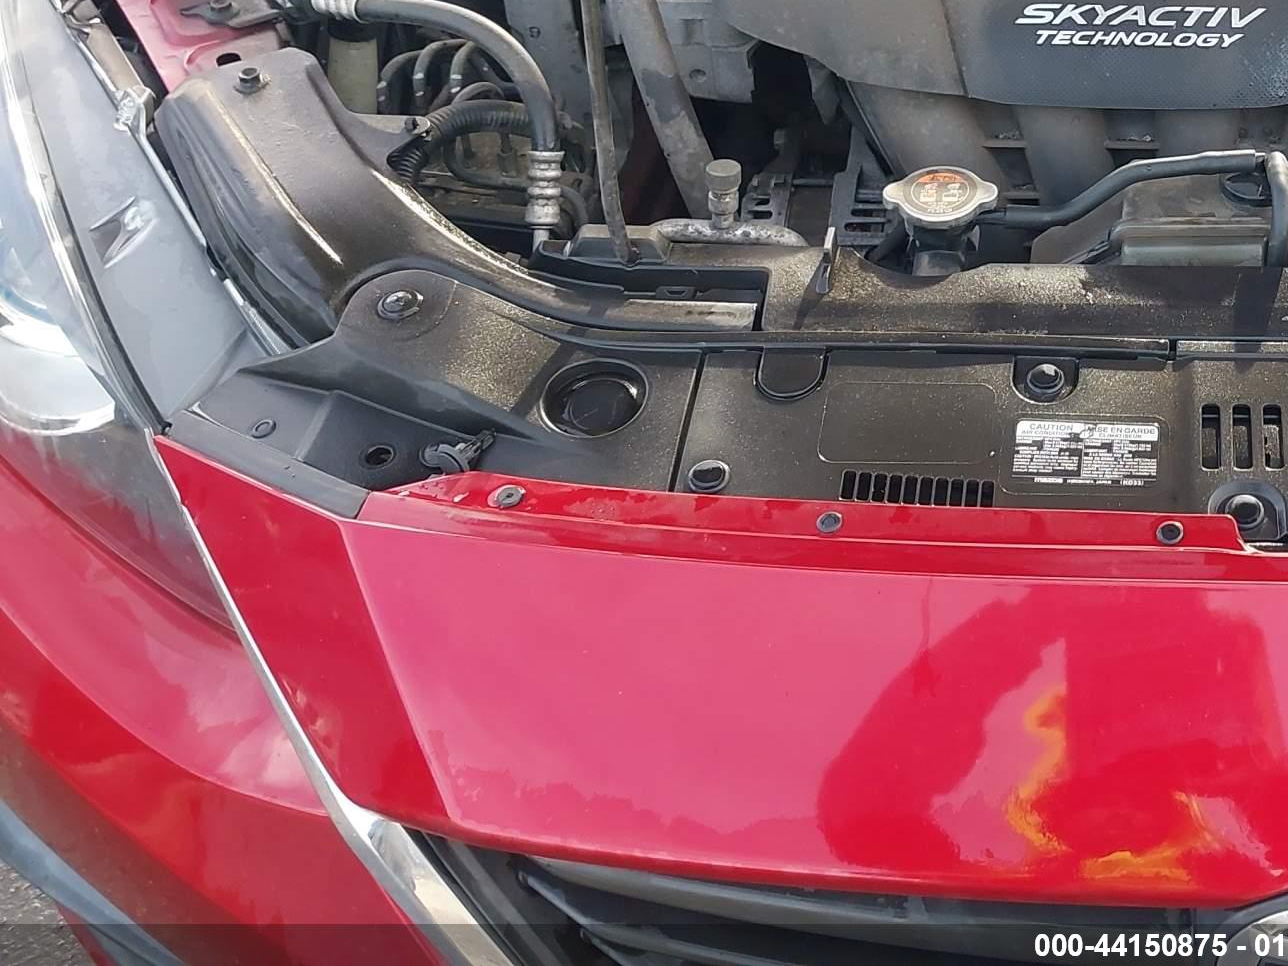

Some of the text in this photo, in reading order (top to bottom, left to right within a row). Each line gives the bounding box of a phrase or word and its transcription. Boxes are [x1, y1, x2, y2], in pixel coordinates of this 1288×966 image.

[1014, 3, 1267, 28] SKYACTIV
[1035, 29, 1244, 48] TECHNOLOGY
[1029, 423, 1074, 431] CAUTION
[1124, 427, 1156, 435] GARDE
